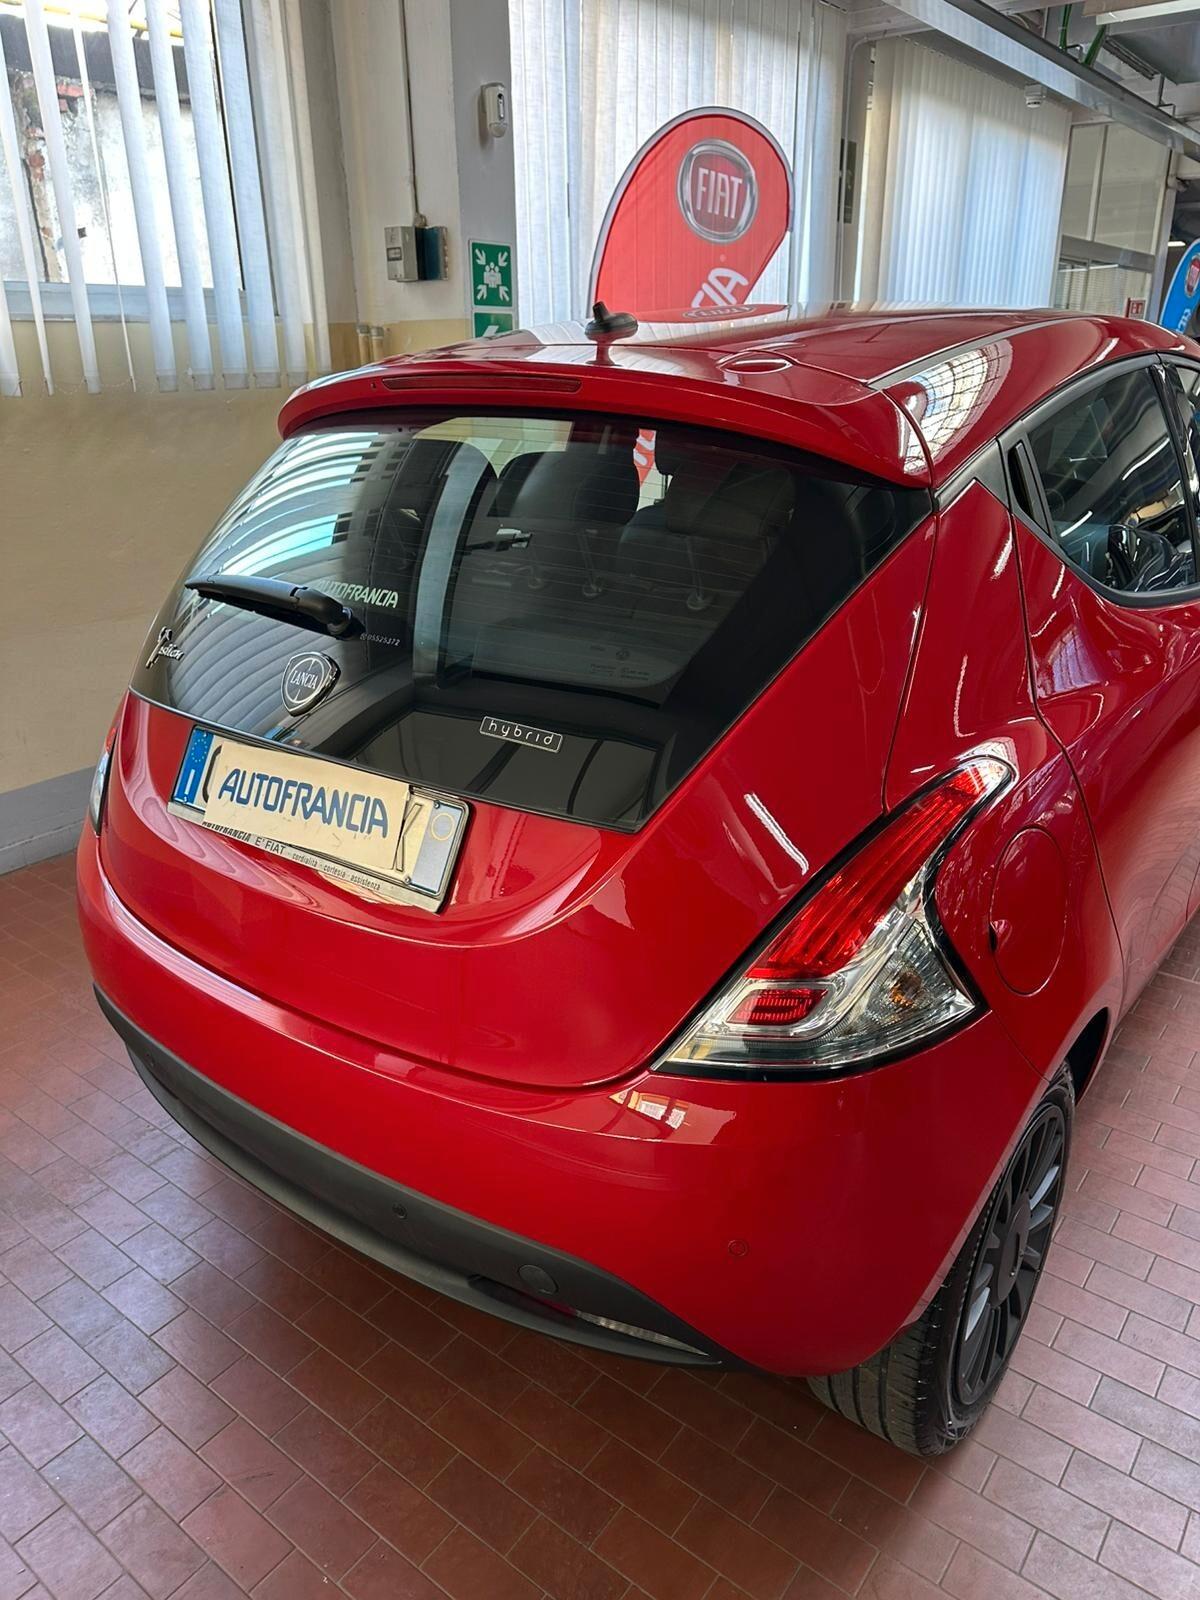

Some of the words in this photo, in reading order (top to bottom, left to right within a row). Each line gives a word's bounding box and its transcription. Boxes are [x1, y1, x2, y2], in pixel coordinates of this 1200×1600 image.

[696, 167, 743, 220] FIAT
[290, 670, 319, 689] LANCIA
[488, 719, 554, 745] hybrid
[218, 768, 389, 839] AUTOFRANCIA
